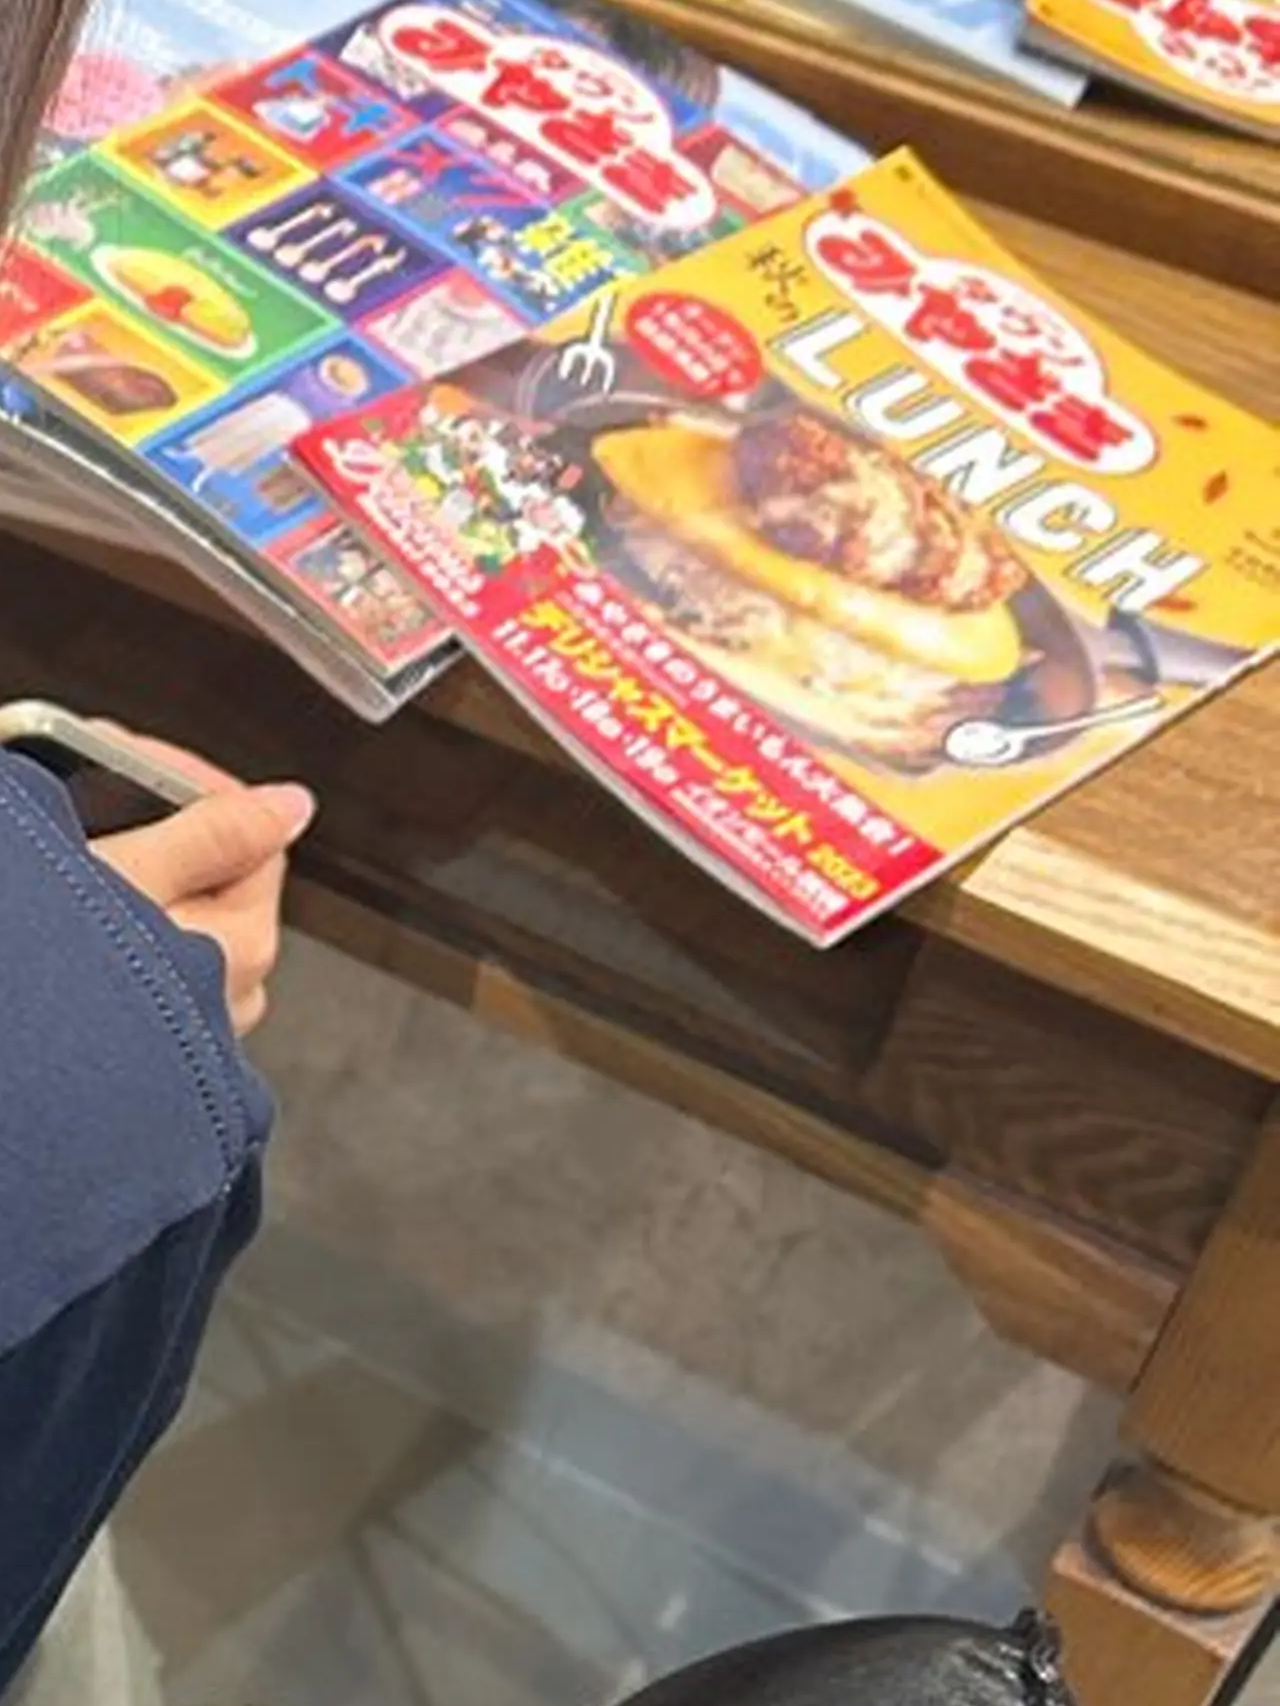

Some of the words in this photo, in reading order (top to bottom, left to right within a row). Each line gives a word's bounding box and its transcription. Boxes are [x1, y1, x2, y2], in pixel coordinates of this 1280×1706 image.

[391, 19, 699, 215] みやざき
[532, 50, 656, 124] タウン
[749, 244, 808, 321] 秋の
[816, 229, 1135, 464] みやざき
[952, 274, 1086, 370] タウン
[768, 305, 1210, 613] LUNCH
[518, 602, 813, 844] デリシャスマーケット
